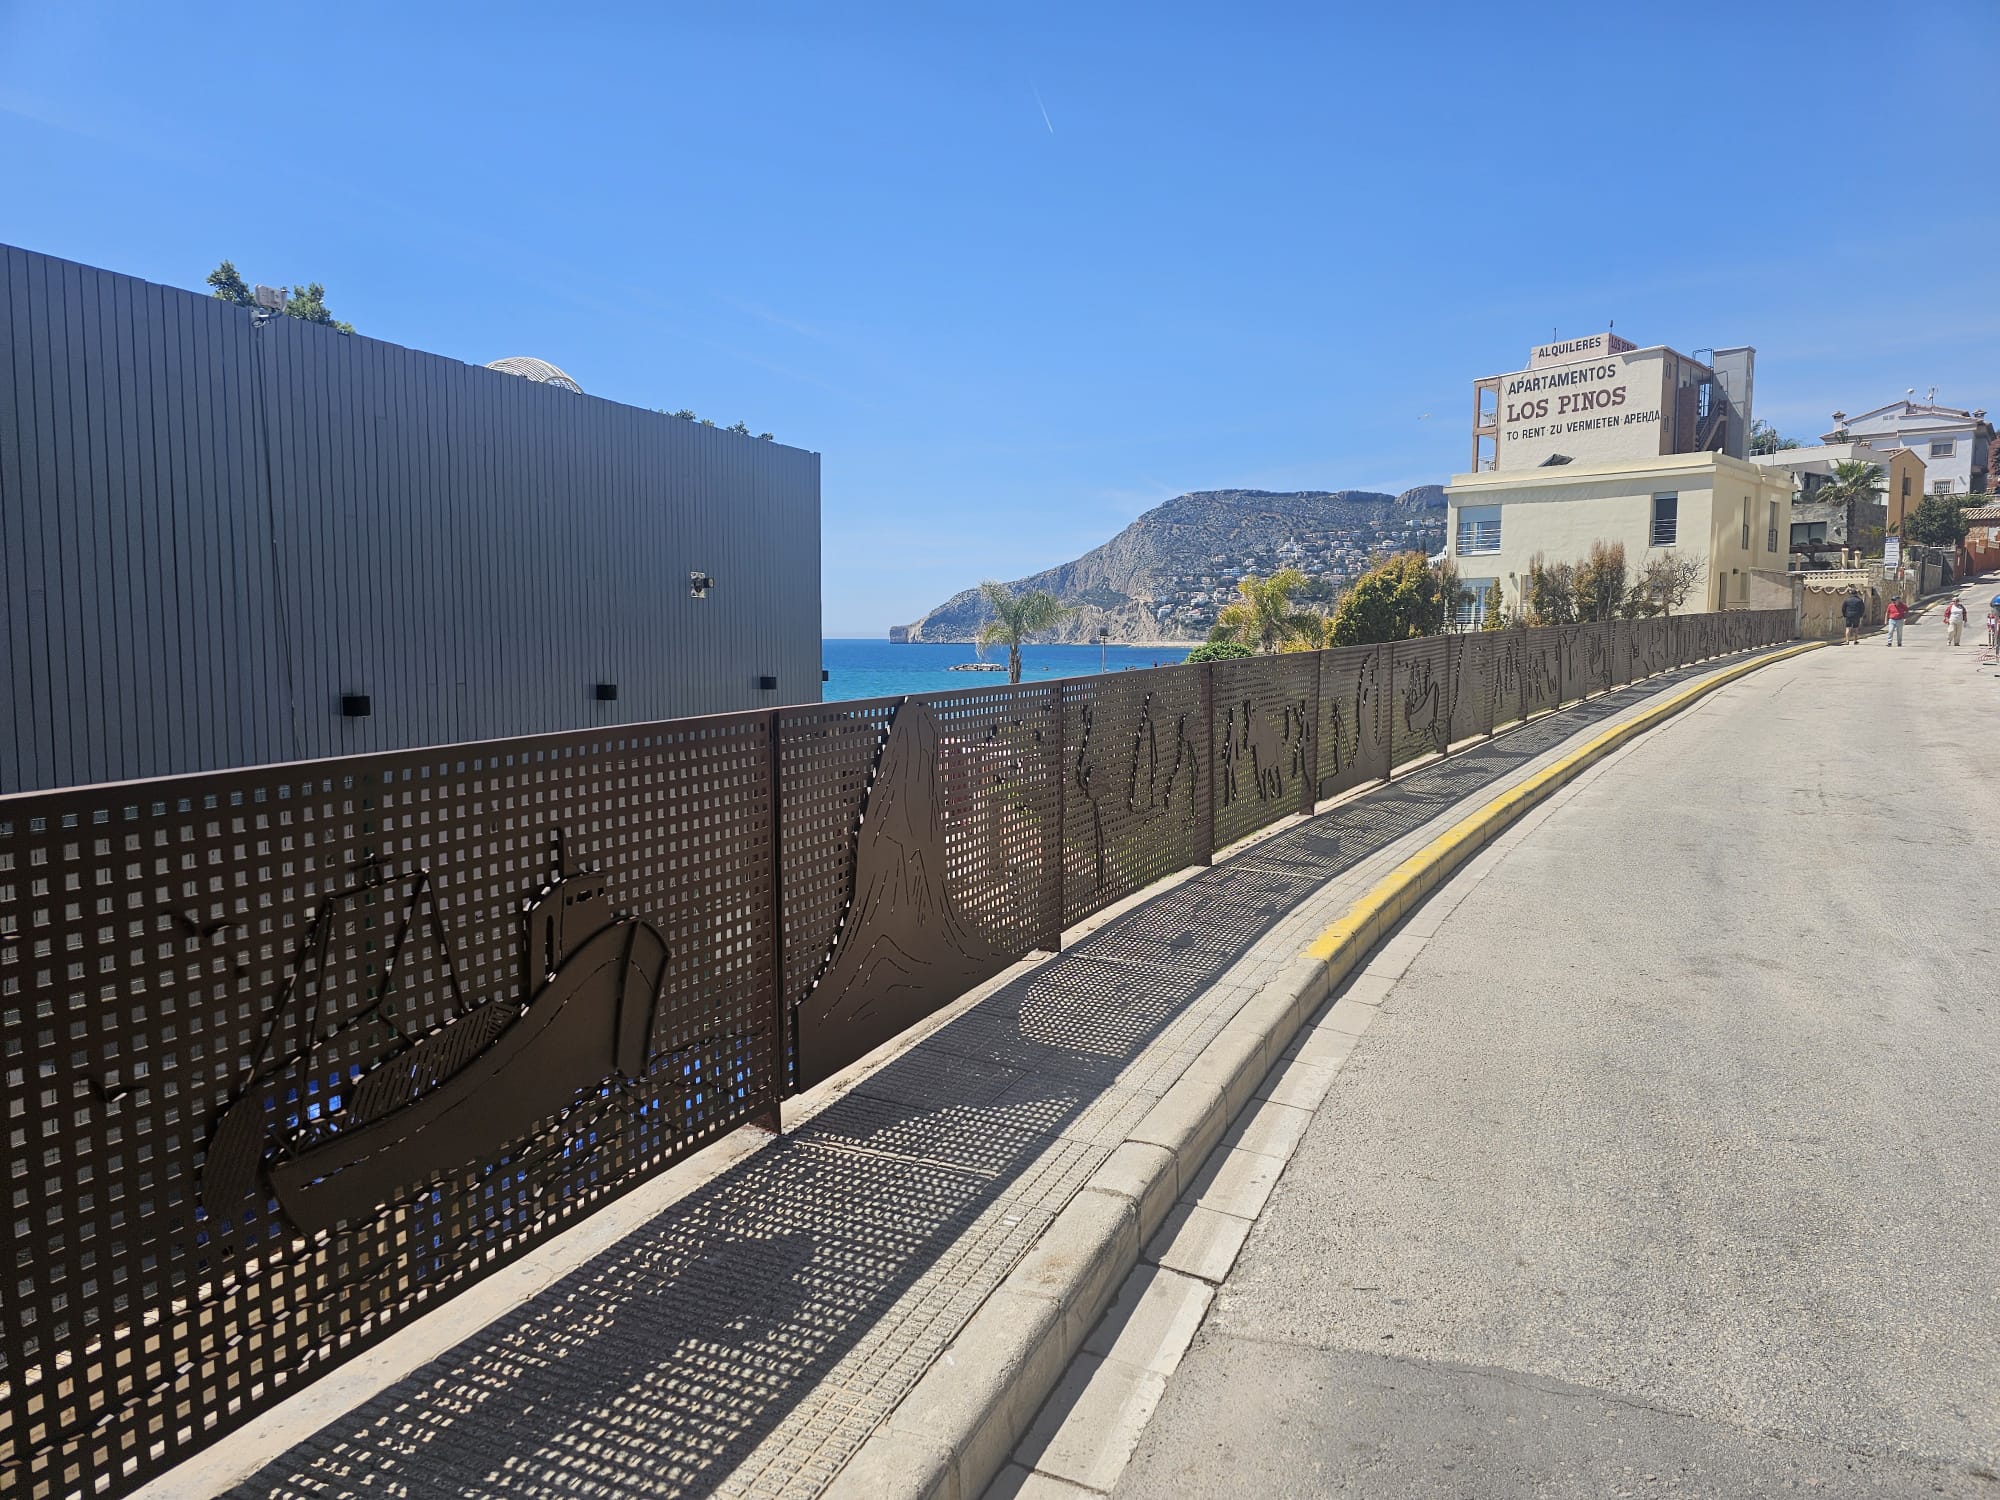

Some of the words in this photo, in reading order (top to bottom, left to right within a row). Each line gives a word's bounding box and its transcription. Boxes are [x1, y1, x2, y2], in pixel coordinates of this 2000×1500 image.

[1538, 337, 1601, 358] ALQUILERES
[1508, 364, 1616, 395] APARTAMENTOS
[1507, 398, 1549, 422] LOS
[1558, 386, 1626, 415] PINOS
[1506, 431, 1519, 441] TO
[1522, 426, 1545, 439] RENT
[1550, 424, 1562, 435] ZU
[1566, 415, 1620, 433] VERMIETEN
[1624, 410, 1660, 425] АРЕНДА
